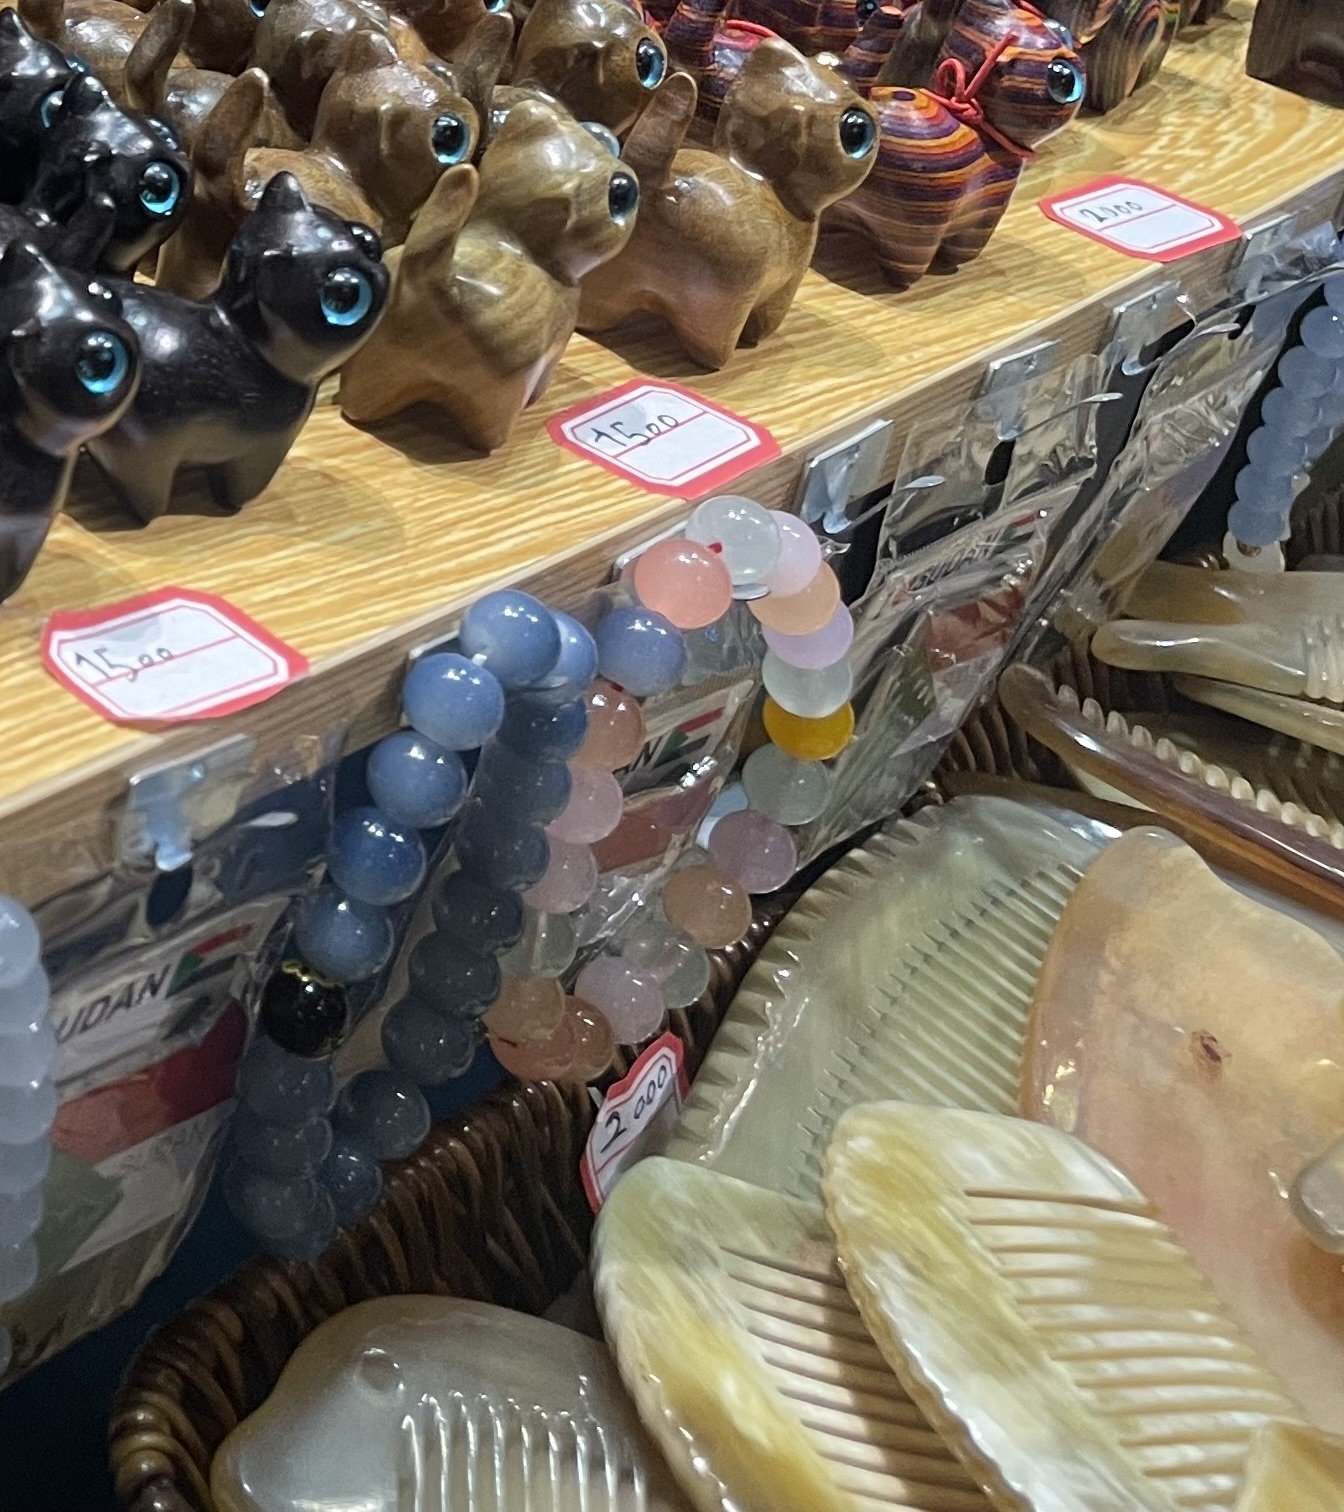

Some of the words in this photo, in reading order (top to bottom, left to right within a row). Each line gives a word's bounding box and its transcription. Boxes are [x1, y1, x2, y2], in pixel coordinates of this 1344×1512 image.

[1079, 201, 1144, 224] 2000
[590, 414, 680, 448] 1500
[74, 646, 174, 683] 1500
[53, 962, 172, 1046] UDAN
